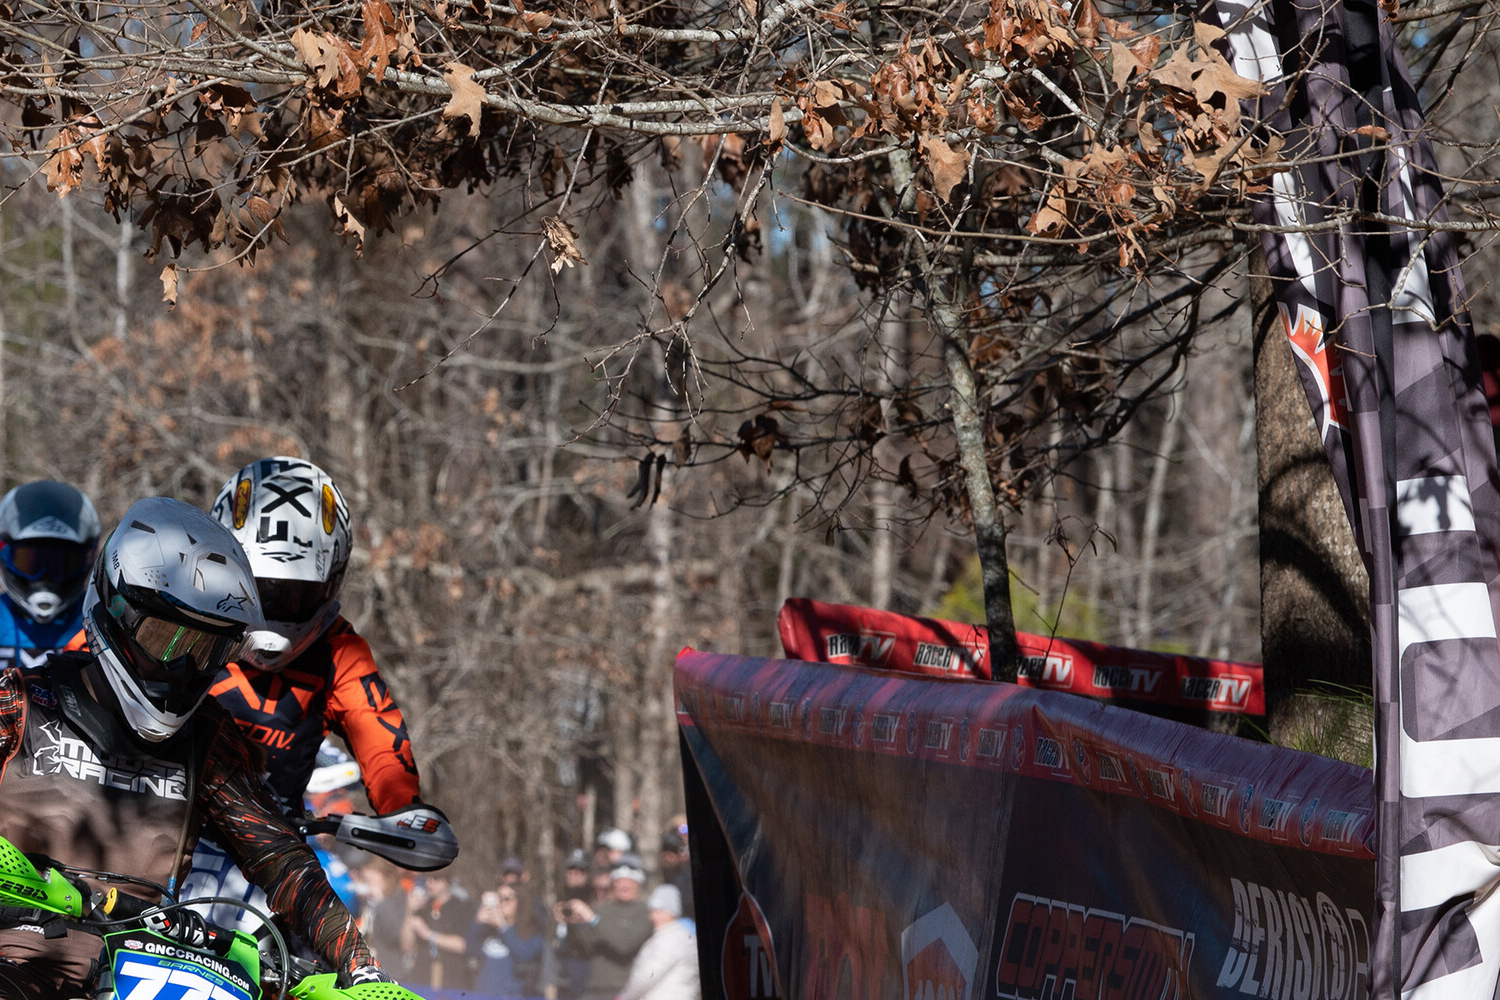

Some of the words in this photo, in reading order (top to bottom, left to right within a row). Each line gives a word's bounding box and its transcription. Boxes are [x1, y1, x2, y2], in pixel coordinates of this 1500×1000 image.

[60, 756, 188, 801] RACING
[145, 942, 251, 991] GNCCRACING.COM
[157, 960, 225, 987] BARNES
